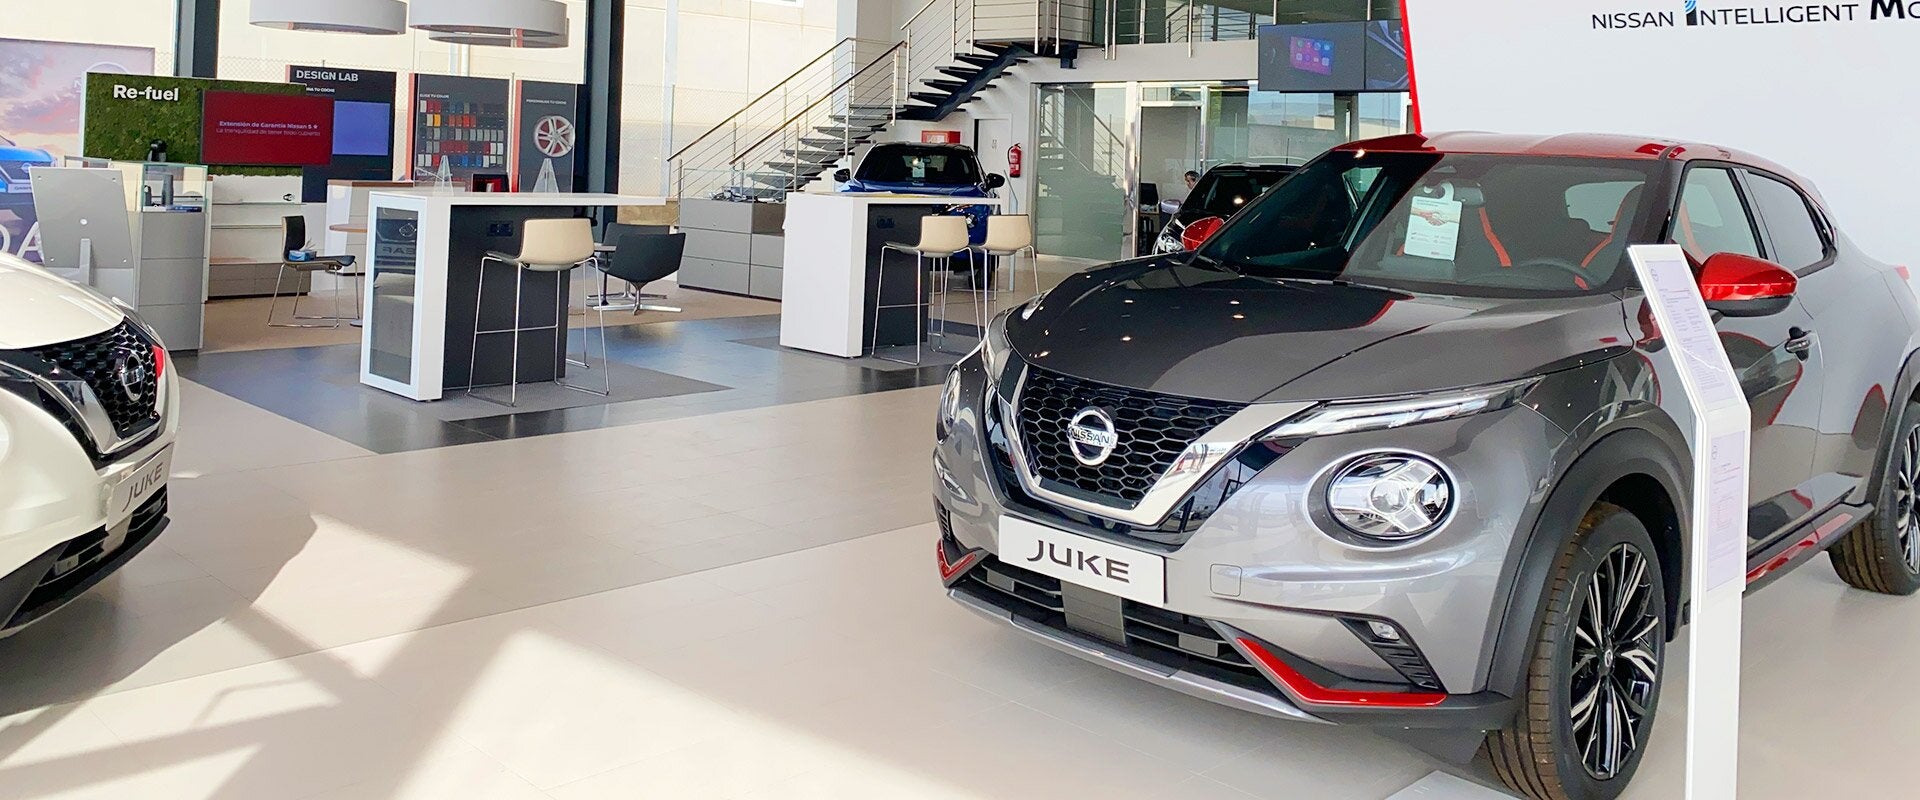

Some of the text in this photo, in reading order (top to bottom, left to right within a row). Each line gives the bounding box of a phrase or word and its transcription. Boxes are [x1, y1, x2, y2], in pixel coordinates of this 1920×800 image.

[1591, 10, 1674, 29] NISSAN
[1685, 0, 1859, 26] INTELLIGENT
[296, 70, 359, 82] DESIGN LAB
[113, 84, 179, 102] Re-fuel
[219, 120, 251, 128] Extensión
[1069, 424, 1111, 446] NISSAN
[122, 462, 164, 512] JUKE
[1026, 539, 1131, 584] JUKE
